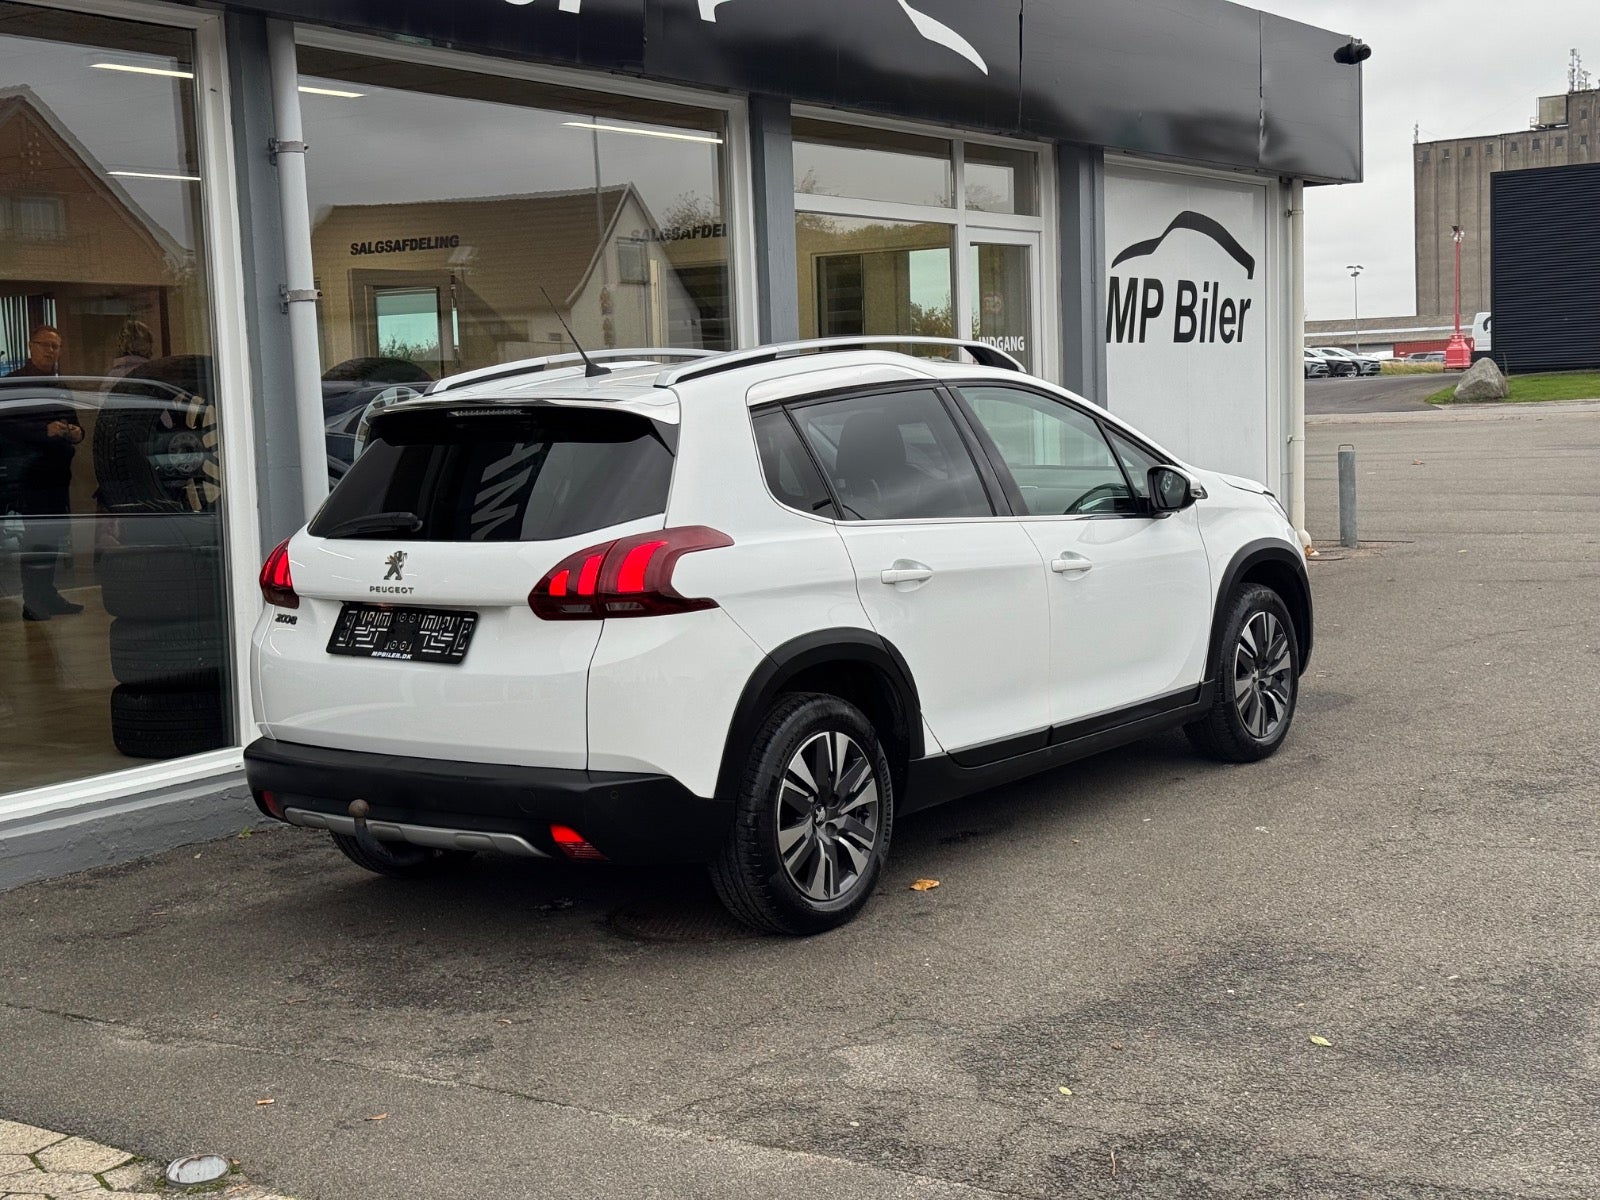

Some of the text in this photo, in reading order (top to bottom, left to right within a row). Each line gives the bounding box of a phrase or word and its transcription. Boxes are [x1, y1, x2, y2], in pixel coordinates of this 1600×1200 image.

[350, 234, 459, 255] SALGSAFDELING
[1106, 276, 1252, 344] MP Biler
[369, 585, 415, 595] PEUGEOT
[275, 613, 298, 625] 2008
